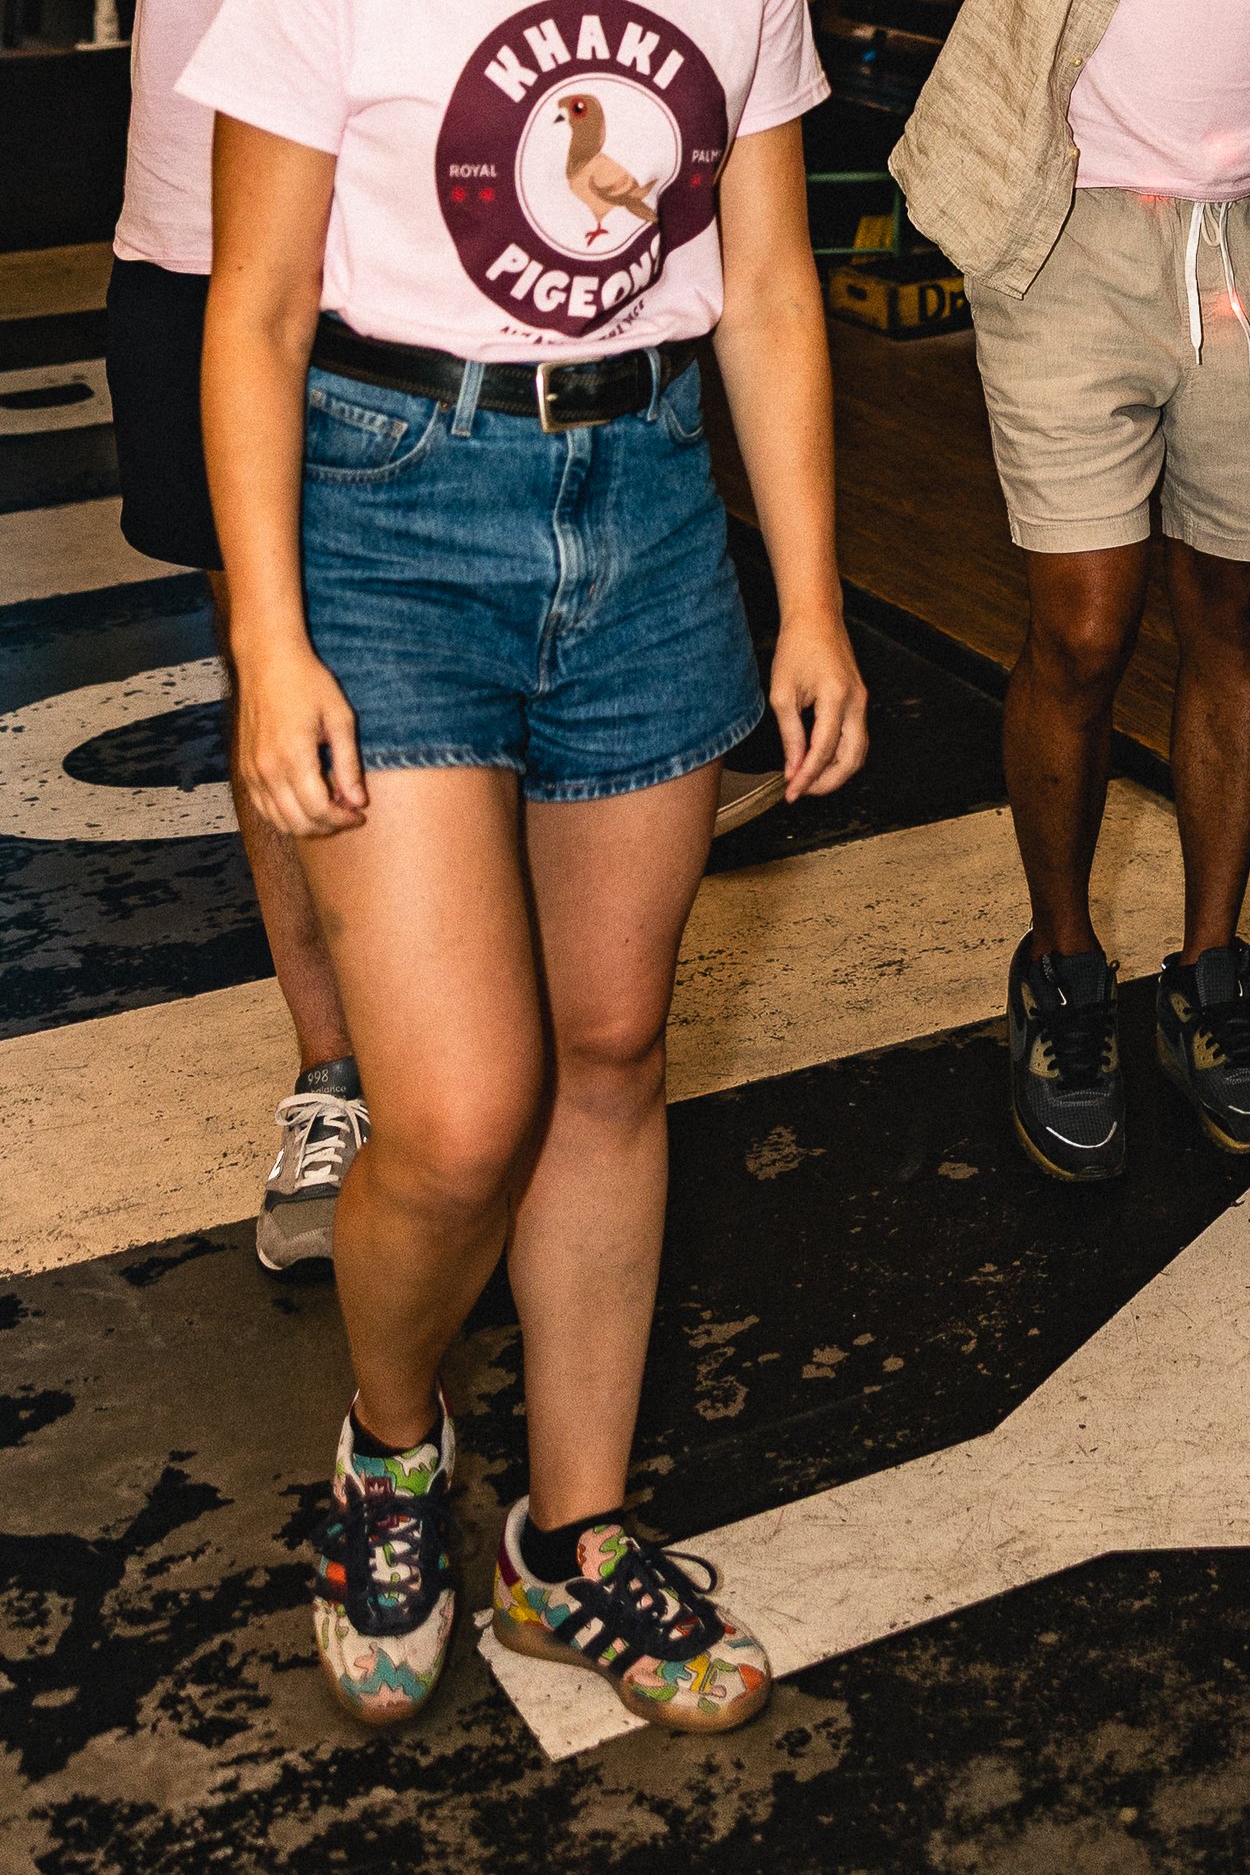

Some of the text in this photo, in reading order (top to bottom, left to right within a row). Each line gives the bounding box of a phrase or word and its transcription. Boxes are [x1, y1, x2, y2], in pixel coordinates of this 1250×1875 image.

[484, 15, 685, 103] KHAKI
[691, 149, 720, 163] PALM
[450, 164, 497, 178] ROYAL
[307, 1069, 329, 1085] 998
